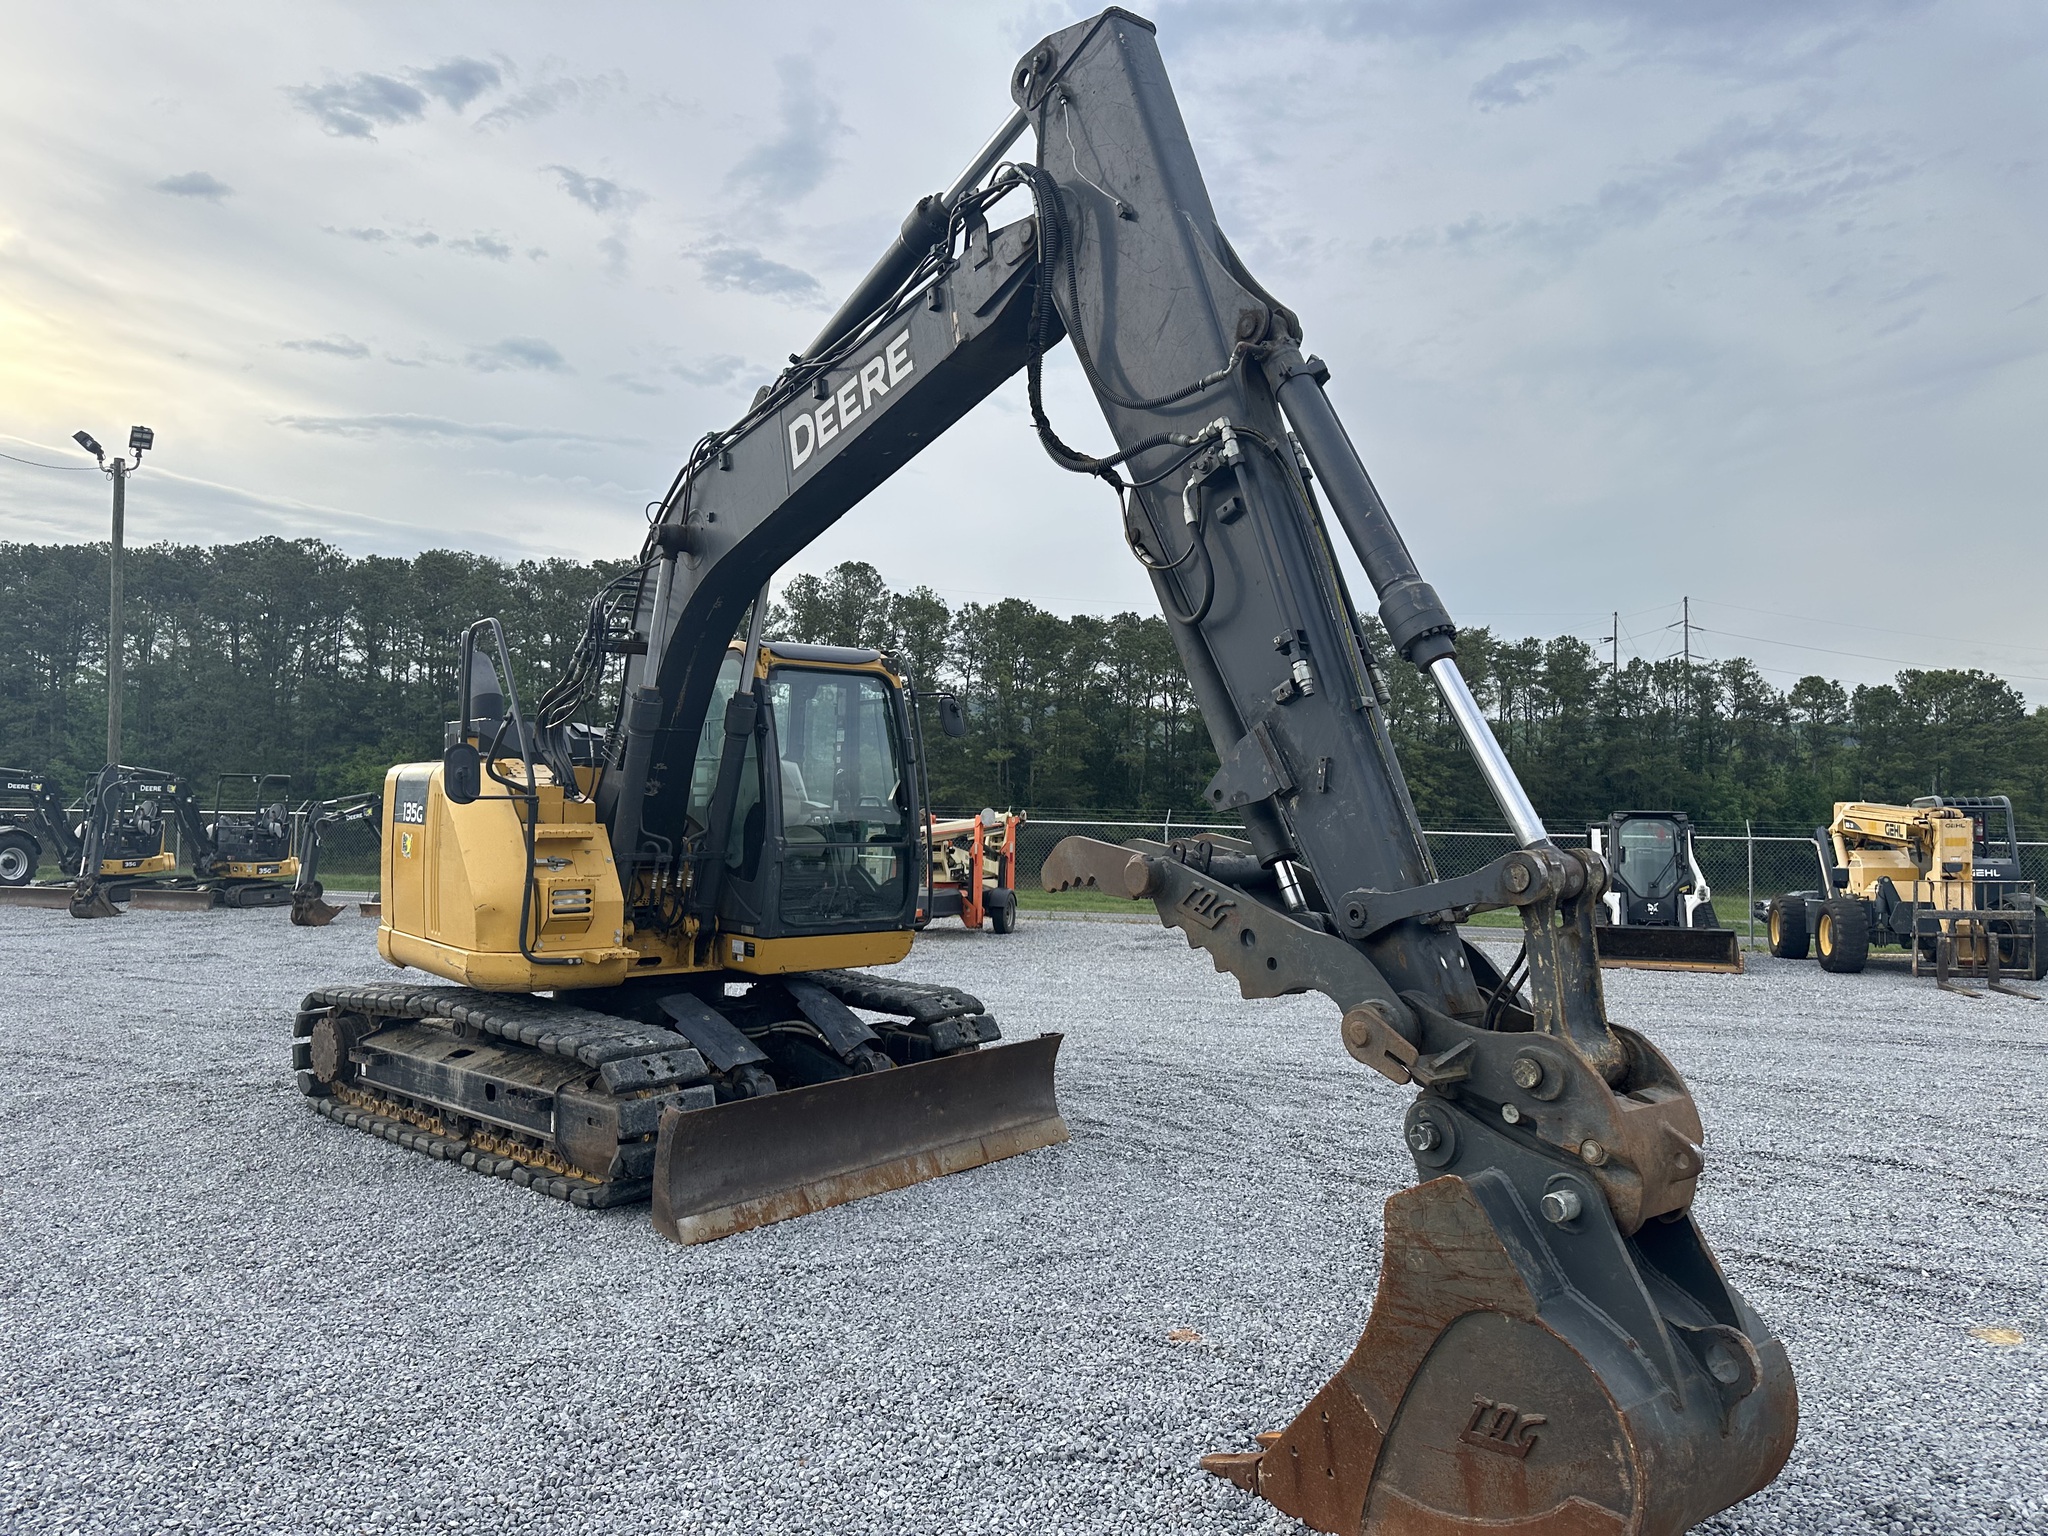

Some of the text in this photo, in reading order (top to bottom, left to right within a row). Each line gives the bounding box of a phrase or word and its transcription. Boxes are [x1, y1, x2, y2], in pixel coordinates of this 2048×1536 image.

[788, 328, 914, 471] DEERE
[7, 782, 30, 790] DEERE
[140, 784, 162, 792] DEERE
[402, 801, 424, 823] 135G
[1883, 823, 1904, 839] GEHL
[258, 866, 272, 875] 35G
[1174, 880, 1236, 931] TAG
[1458, 1392, 1548, 1460] TAG
